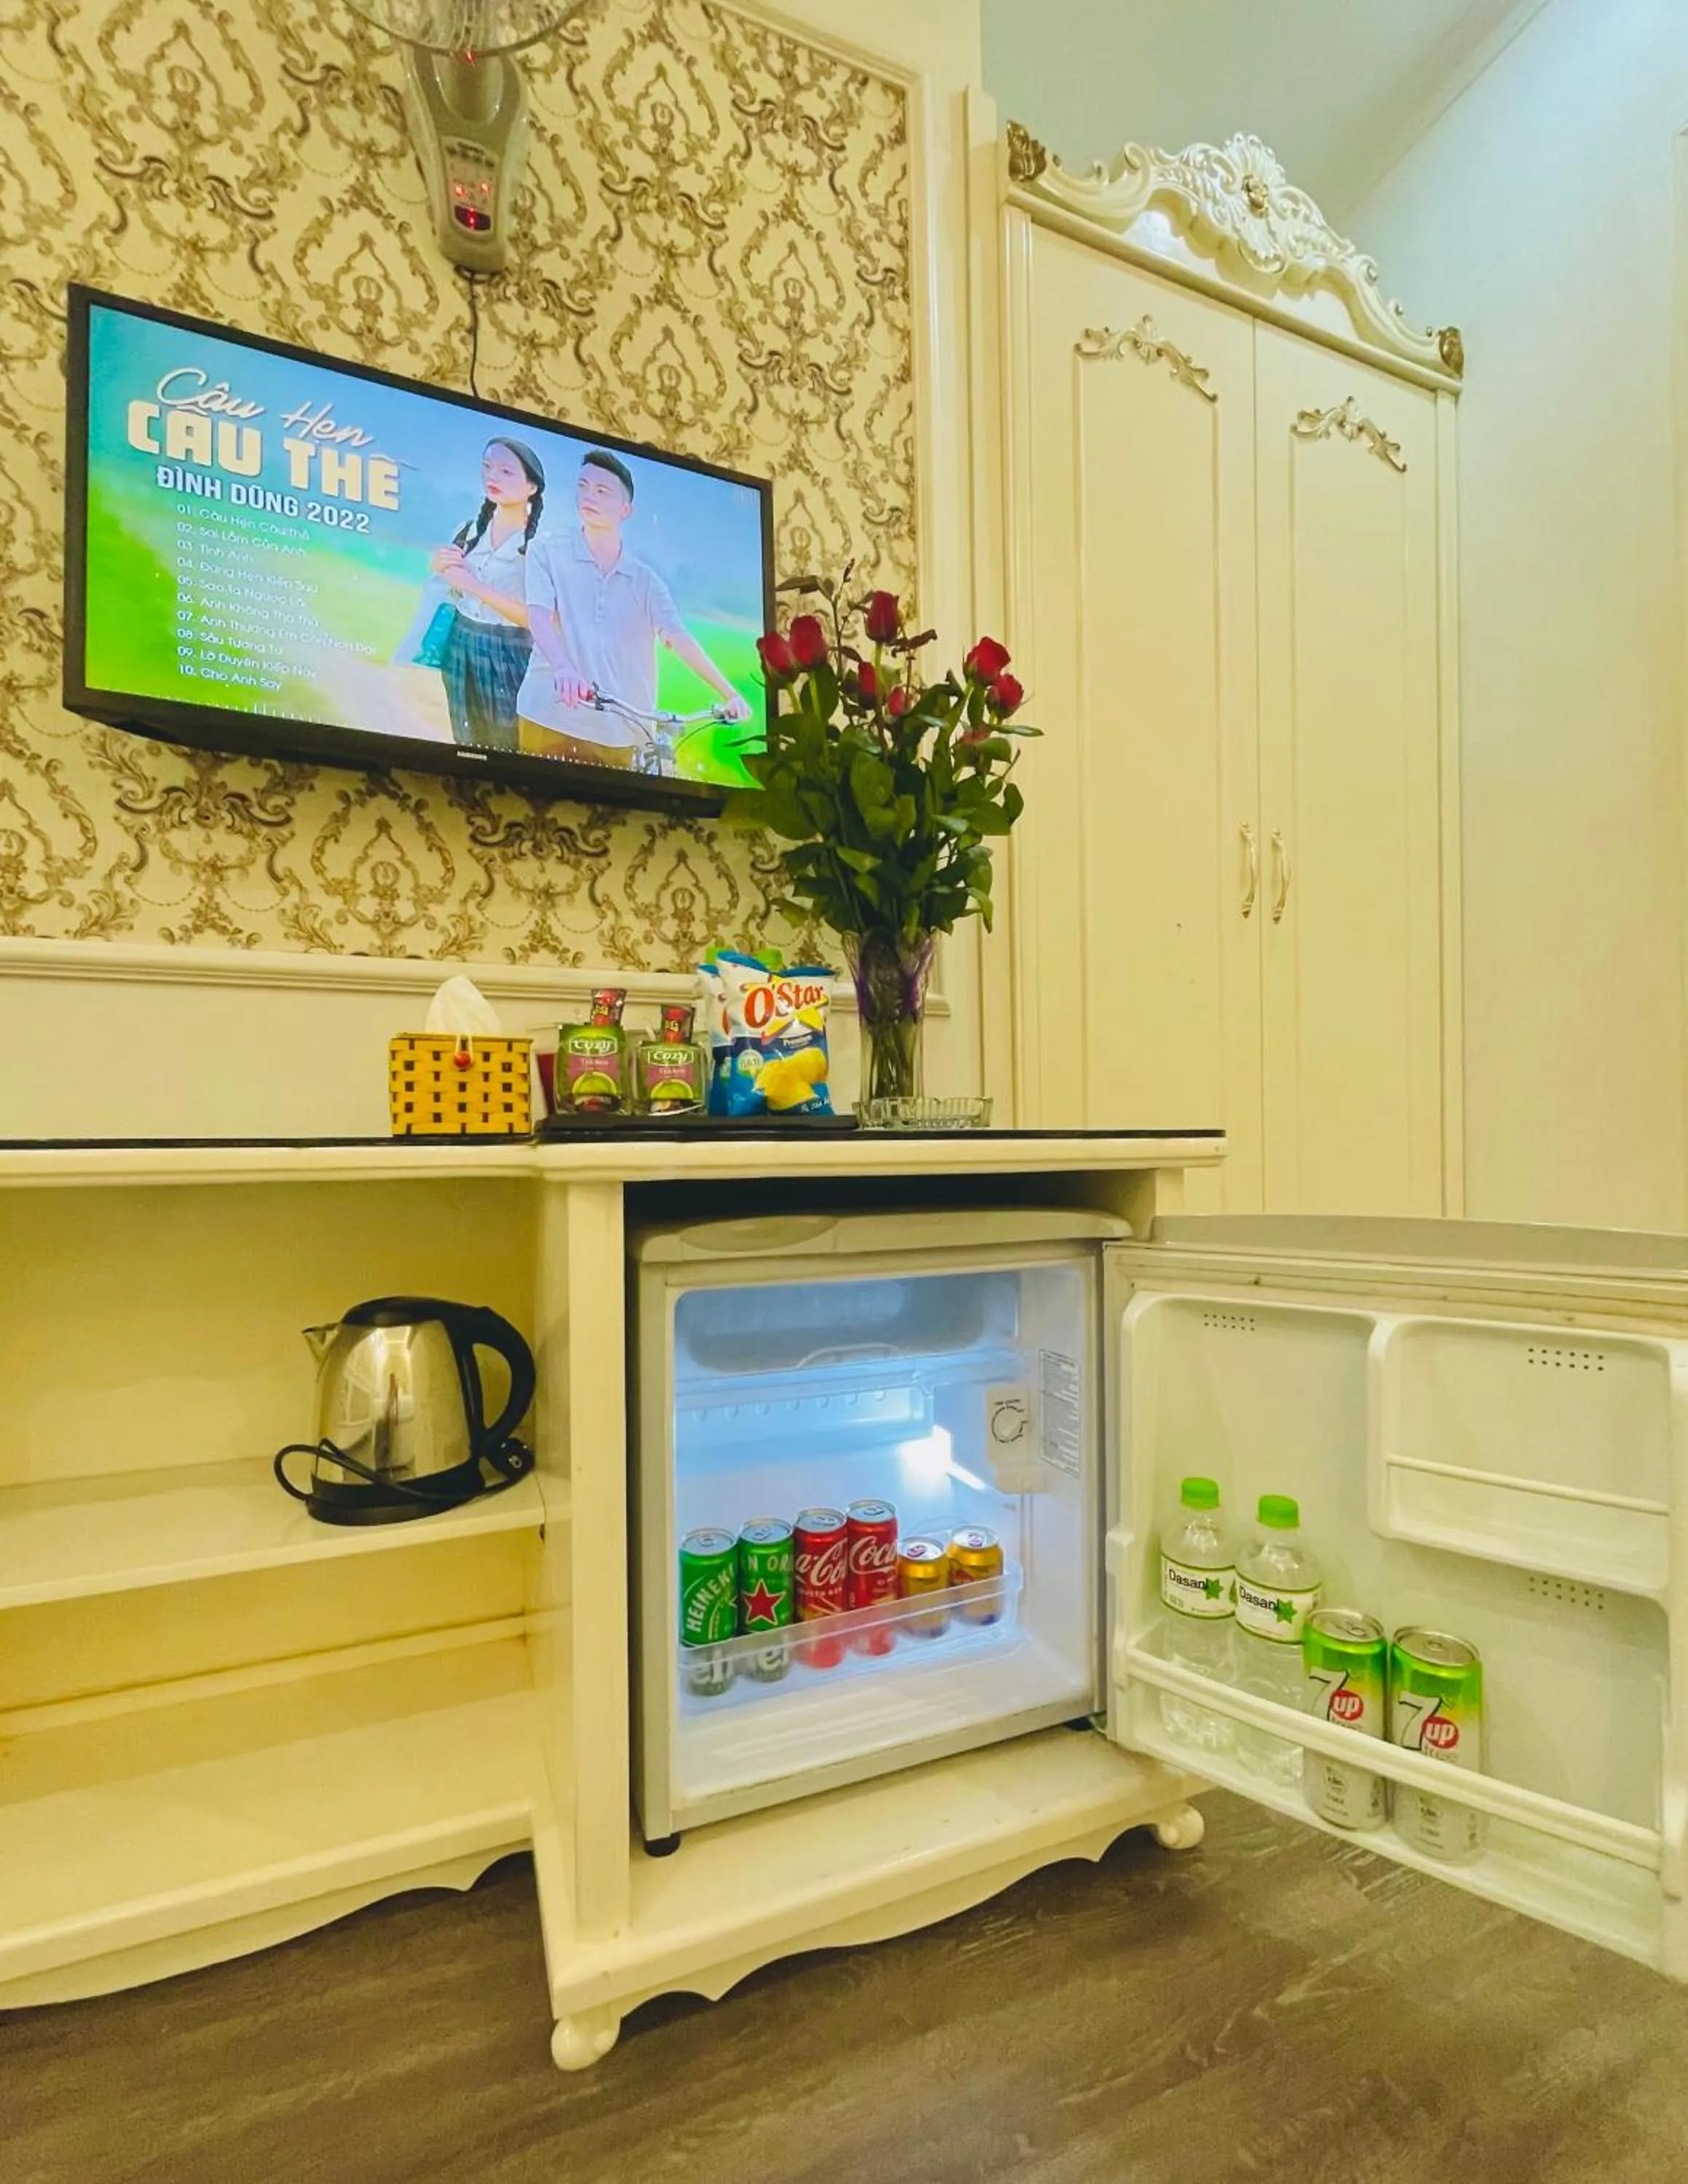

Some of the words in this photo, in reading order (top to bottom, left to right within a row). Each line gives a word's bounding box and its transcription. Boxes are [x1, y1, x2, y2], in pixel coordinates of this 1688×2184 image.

[157, 367, 266, 419] Câu
[127, 400, 262, 477] CÂU
[157, 465, 222, 499] ĐÌNH
[307, 501, 370, 534] 2022
[231, 672, 257, 687] Anh
[744, 981, 825, 1029] O'Star
[573, 1038, 612, 1056] Cozy
[652, 1050, 689, 1066] Cozy
[1168, 1568, 1210, 1591] Dasani
[1238, 1584, 1280, 1610] Dasani
